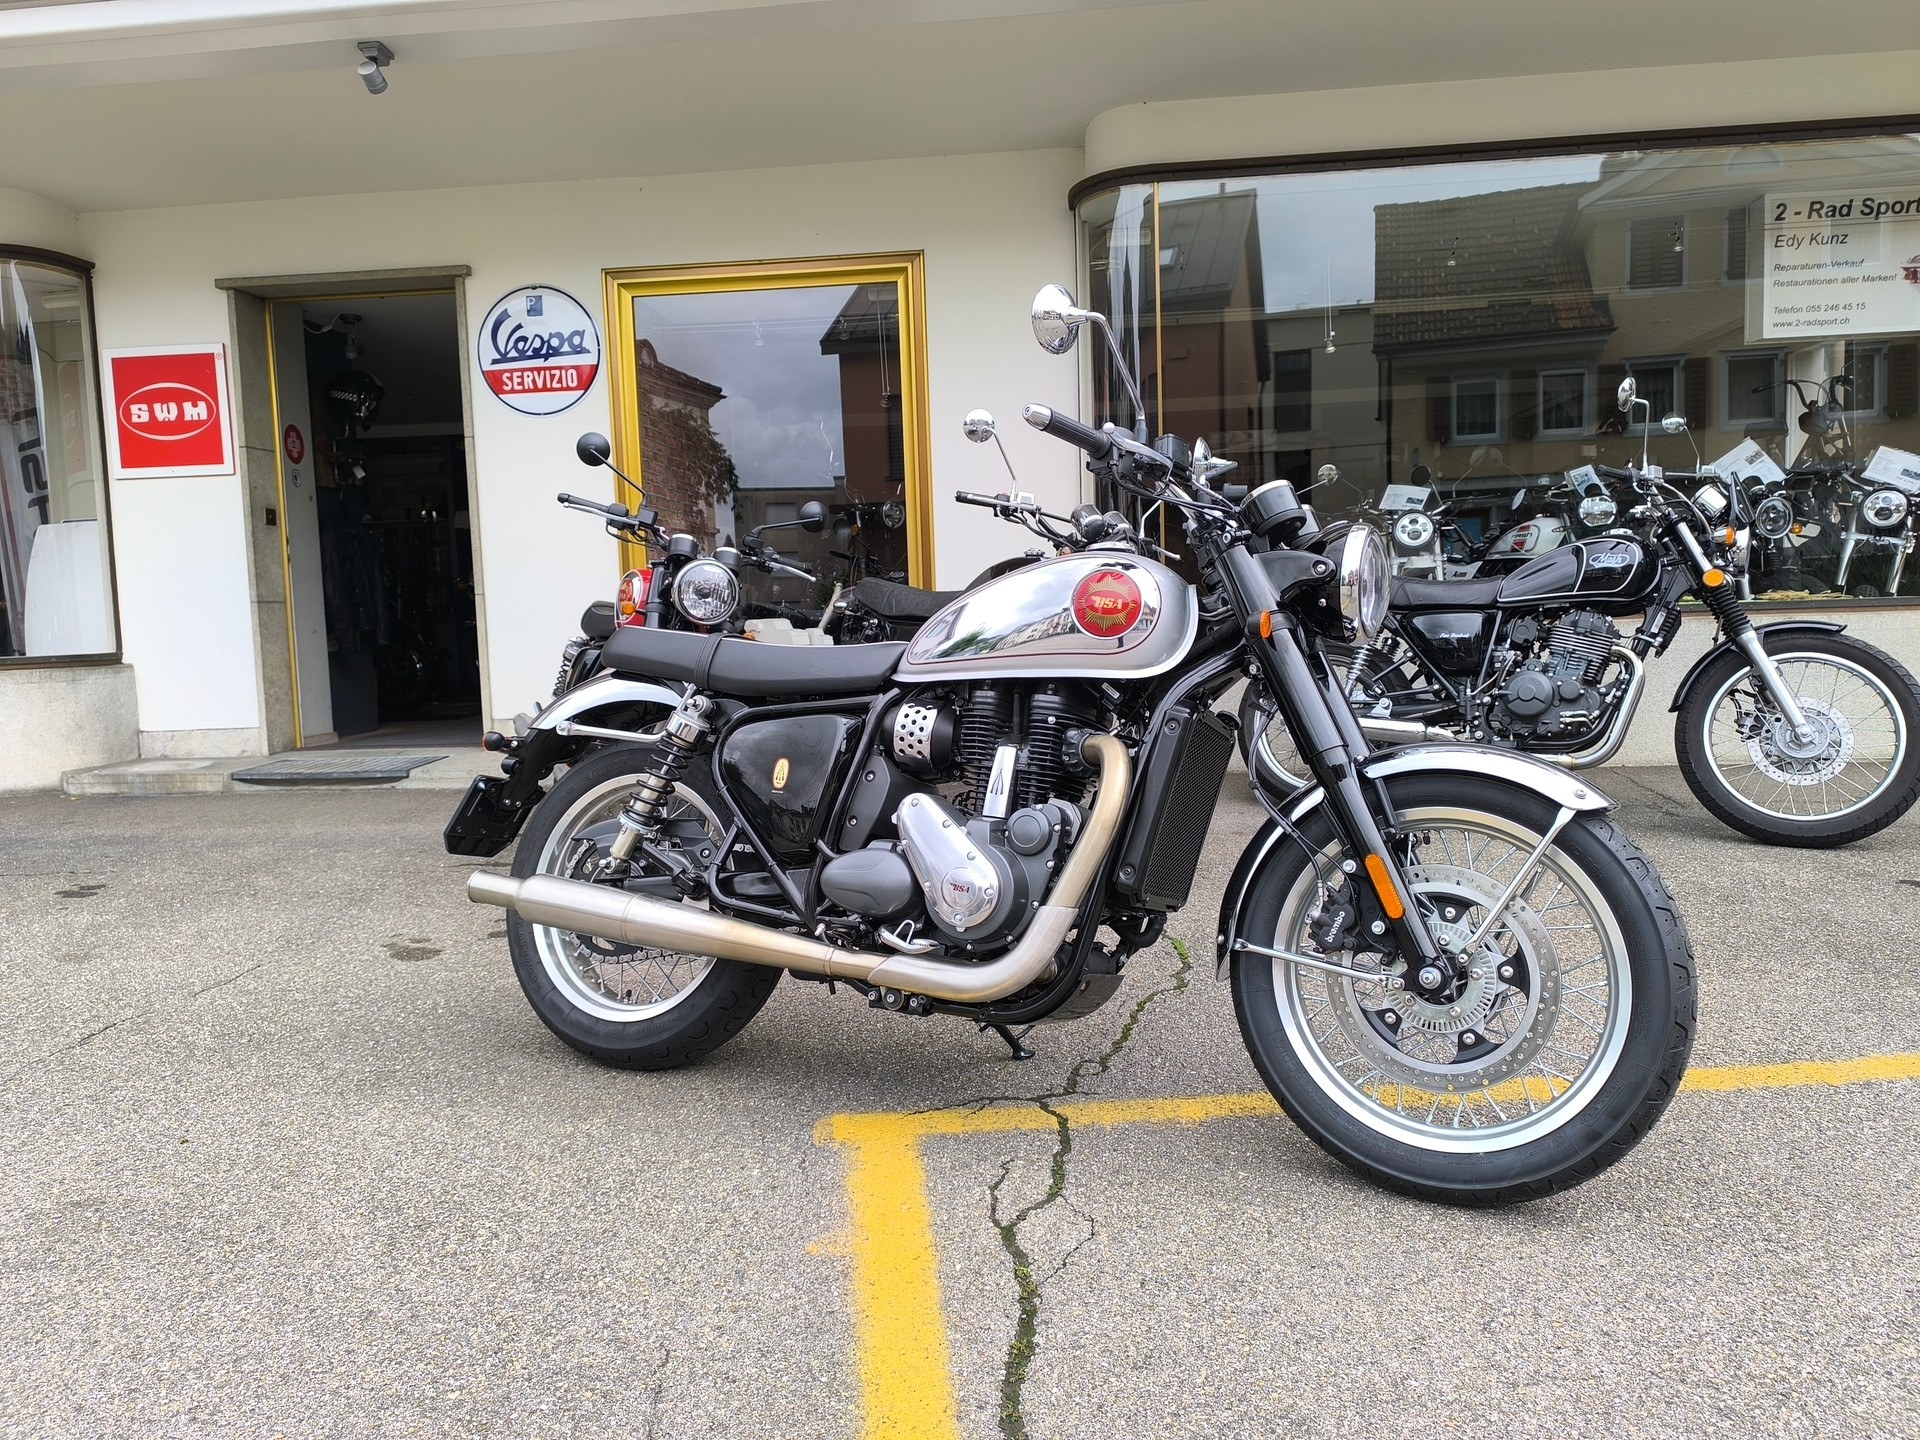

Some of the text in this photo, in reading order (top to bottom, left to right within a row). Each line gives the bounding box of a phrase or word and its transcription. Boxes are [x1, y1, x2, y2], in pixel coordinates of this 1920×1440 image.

[1774, 203, 1788, 222] 2
[1807, 198, 1854, 220] Rad
[1774, 232, 1849, 250] Edy Kunz
[1773, 259, 1865, 272] Reparaturen-Verkauf
[1773, 274, 1897, 288] Restaurationen aller Marken!
[1773, 302, 1866, 315] Telefon 055 246 45 15
[1773, 316, 1850, 329] www.2-radsport.ch
[490, 308, 592, 365] Vespa
[502, 369, 579, 391] SERVIZIO
[129, 401, 208, 423] SWM
[1090, 595, 1123, 610] BSA
[949, 882, 970, 894] BSA
[1324, 911, 1346, 943] brembo
